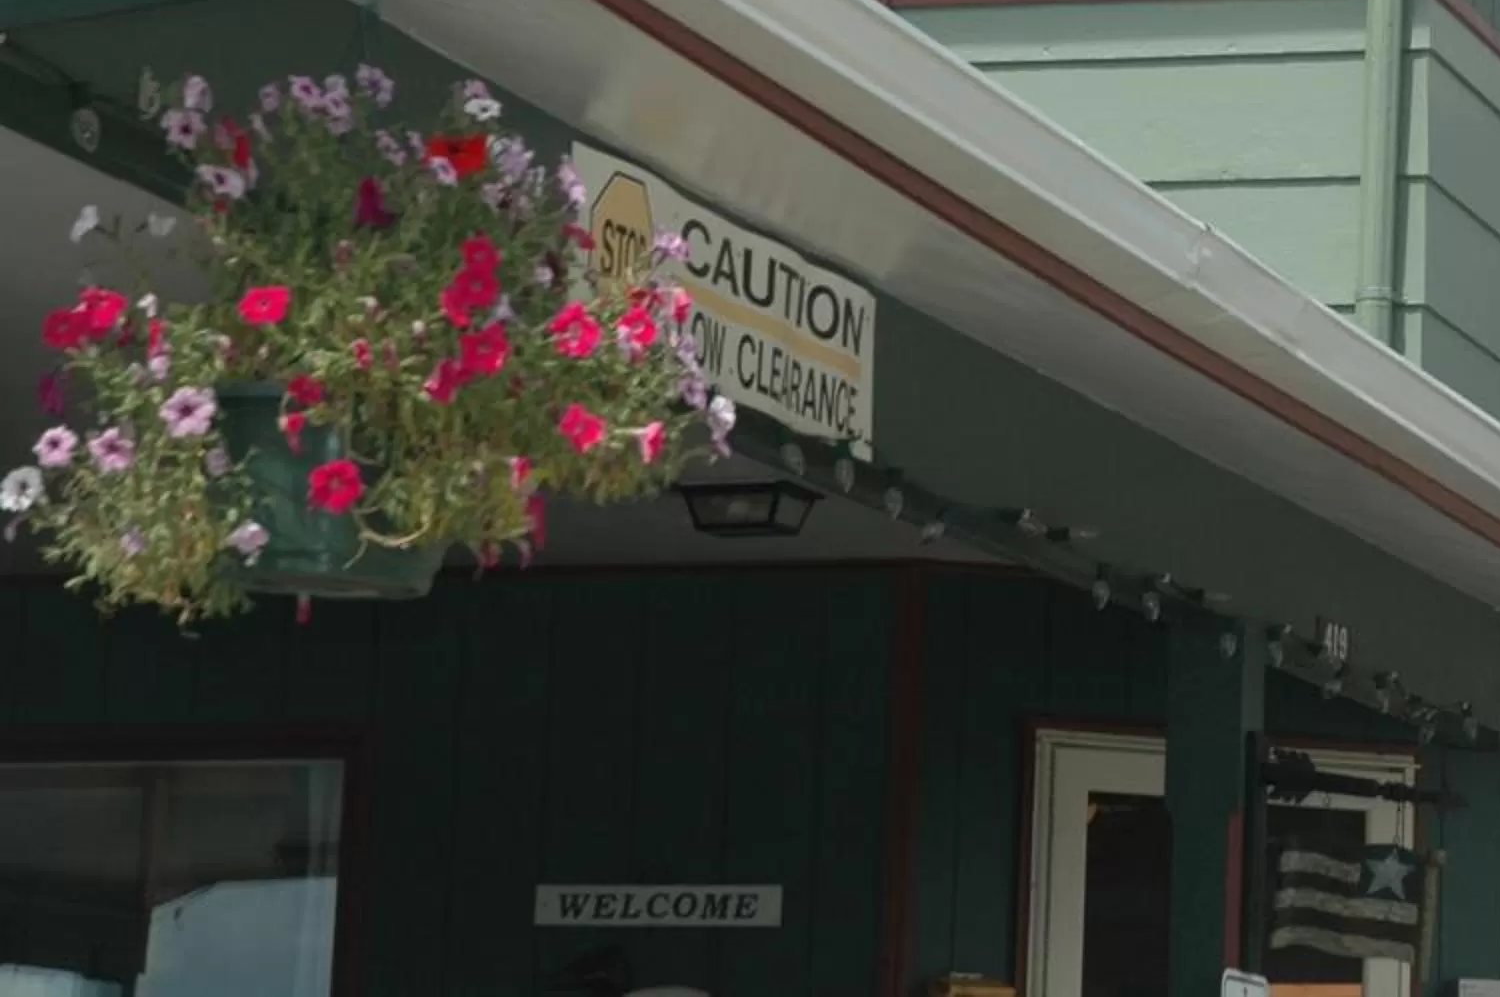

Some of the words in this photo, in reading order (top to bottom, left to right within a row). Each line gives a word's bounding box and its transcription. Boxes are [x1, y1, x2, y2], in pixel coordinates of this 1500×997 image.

[600, 218, 648, 280] STO
[681, 219, 864, 355] CAUTION
[677, 310, 727, 377] OW
[737, 334, 863, 439] CLEARANCE
[557, 892, 760, 921] WELCOME
